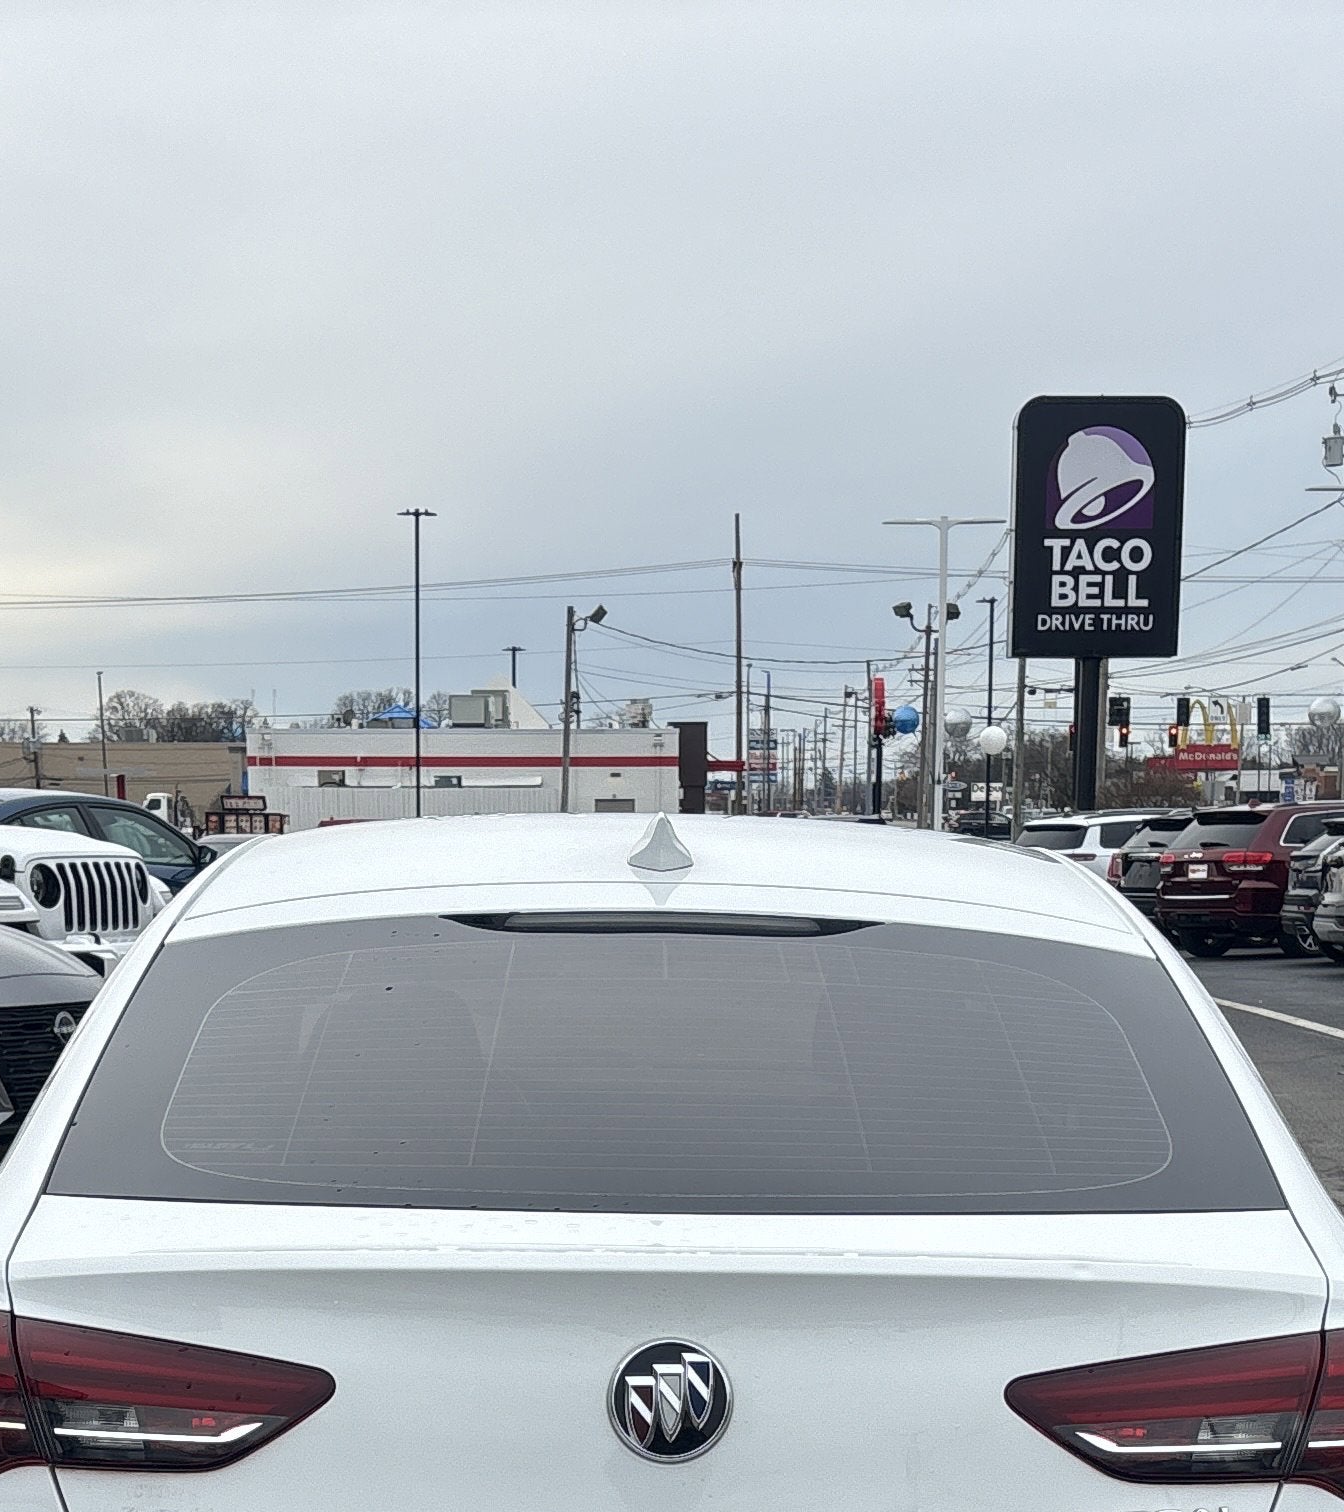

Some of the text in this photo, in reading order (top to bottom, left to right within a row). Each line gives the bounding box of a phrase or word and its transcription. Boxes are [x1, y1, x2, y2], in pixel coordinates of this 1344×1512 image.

[1043, 537, 1153, 572] TACO
[1050, 574, 1149, 607] BELL
[1037, 614, 1154, 631] DRIVE THRU
